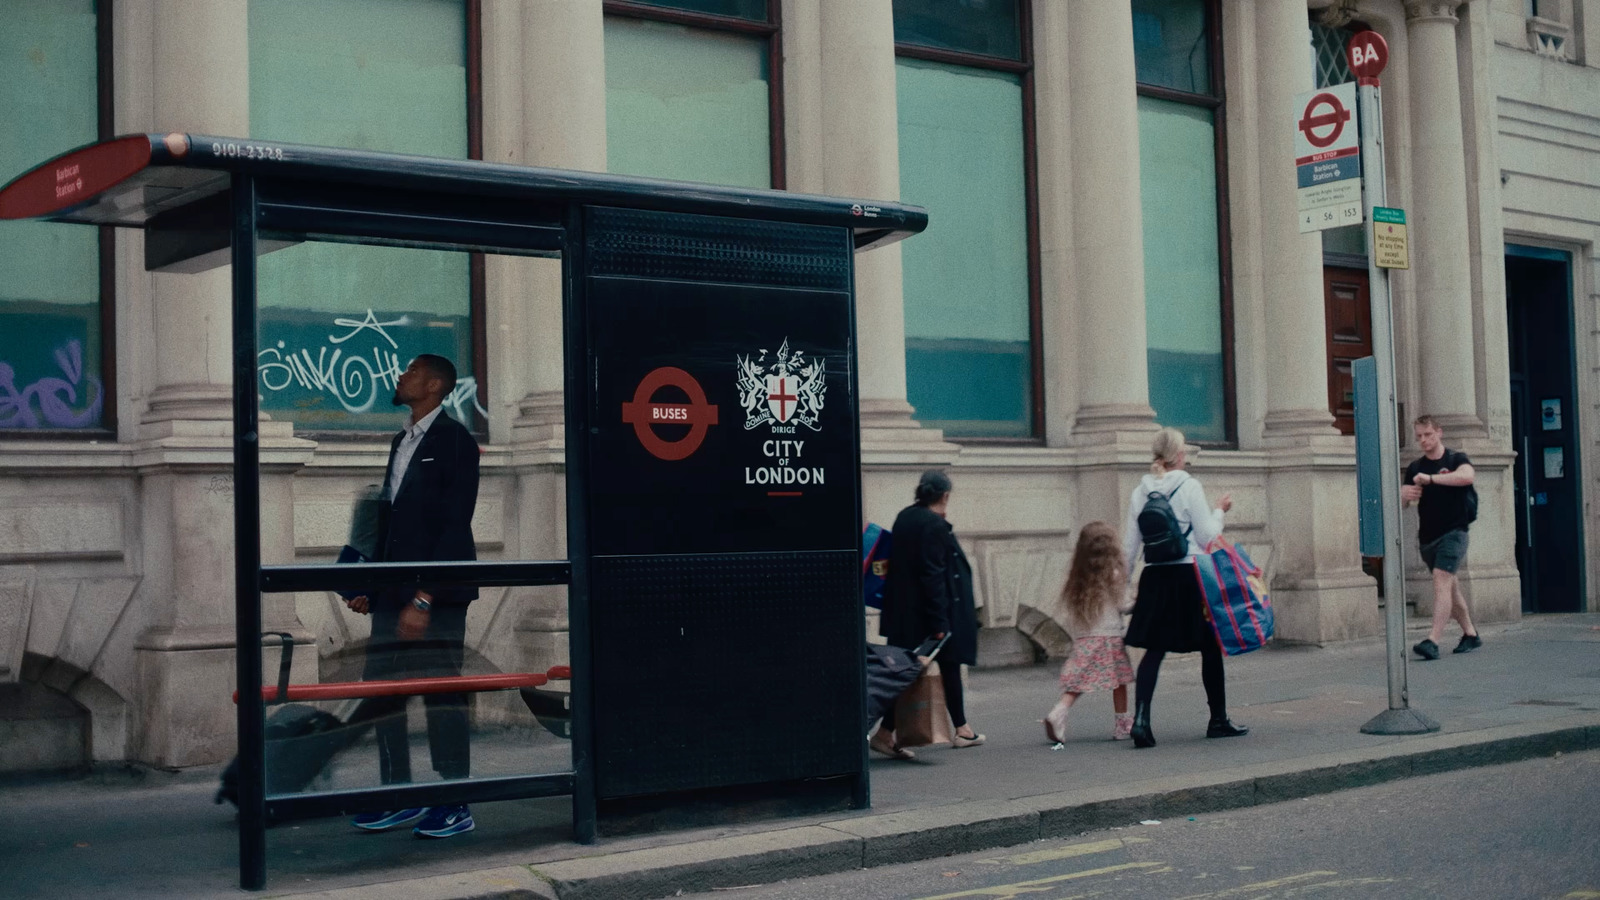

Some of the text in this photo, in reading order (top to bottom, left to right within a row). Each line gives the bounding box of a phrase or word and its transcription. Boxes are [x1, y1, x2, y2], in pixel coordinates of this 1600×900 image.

[1352, 42, 1380, 67] BA
[246, 145, 283, 161] 2328
[56, 164, 80, 181] Barbican
[1313, 163, 1338, 173] Barbican
[1312, 172, 1333, 181] Station
[55, 183, 76, 198] Station
[1323, 211, 1333, 221] 56
[1344, 208, 1357, 217] 153
[652, 407, 688, 420] BUSES
[745, 411, 813, 434] DOMINE DIRIGE NOS
[763, 440, 805, 457] CITY
[778, 458, 789, 466] OF
[745, 467, 825, 485] LONDON
